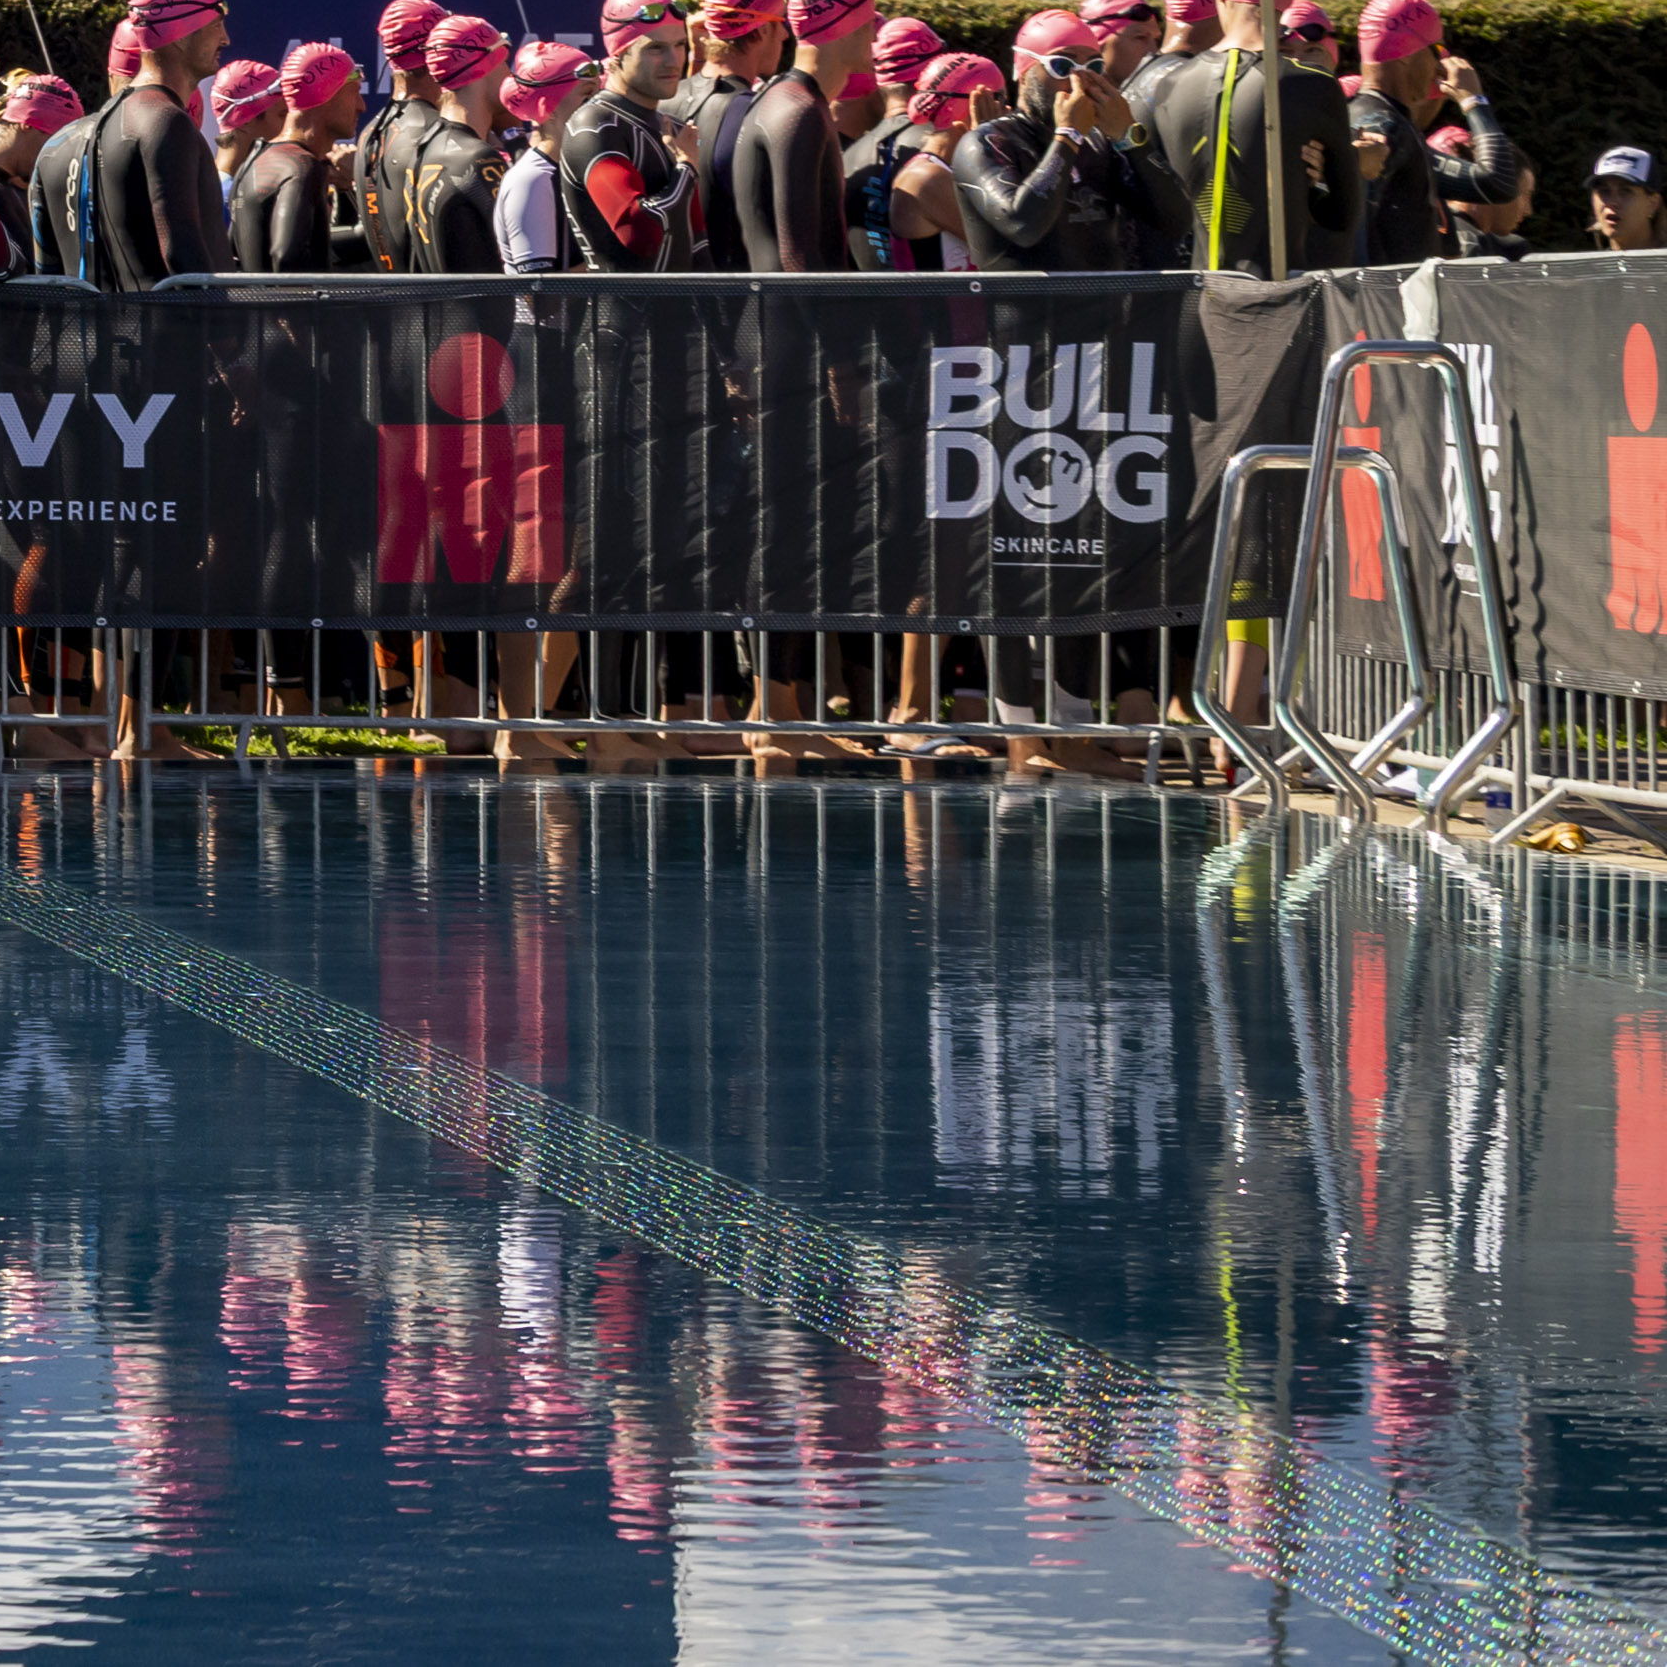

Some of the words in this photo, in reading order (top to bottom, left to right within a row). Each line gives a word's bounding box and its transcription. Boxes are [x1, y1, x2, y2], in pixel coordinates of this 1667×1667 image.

[65, 157, 80, 232] orca
[927, 341, 1173, 433] BULL
[925, 430, 1169, 524] DOG
[992, 536, 1105, 555] SKINCARE
